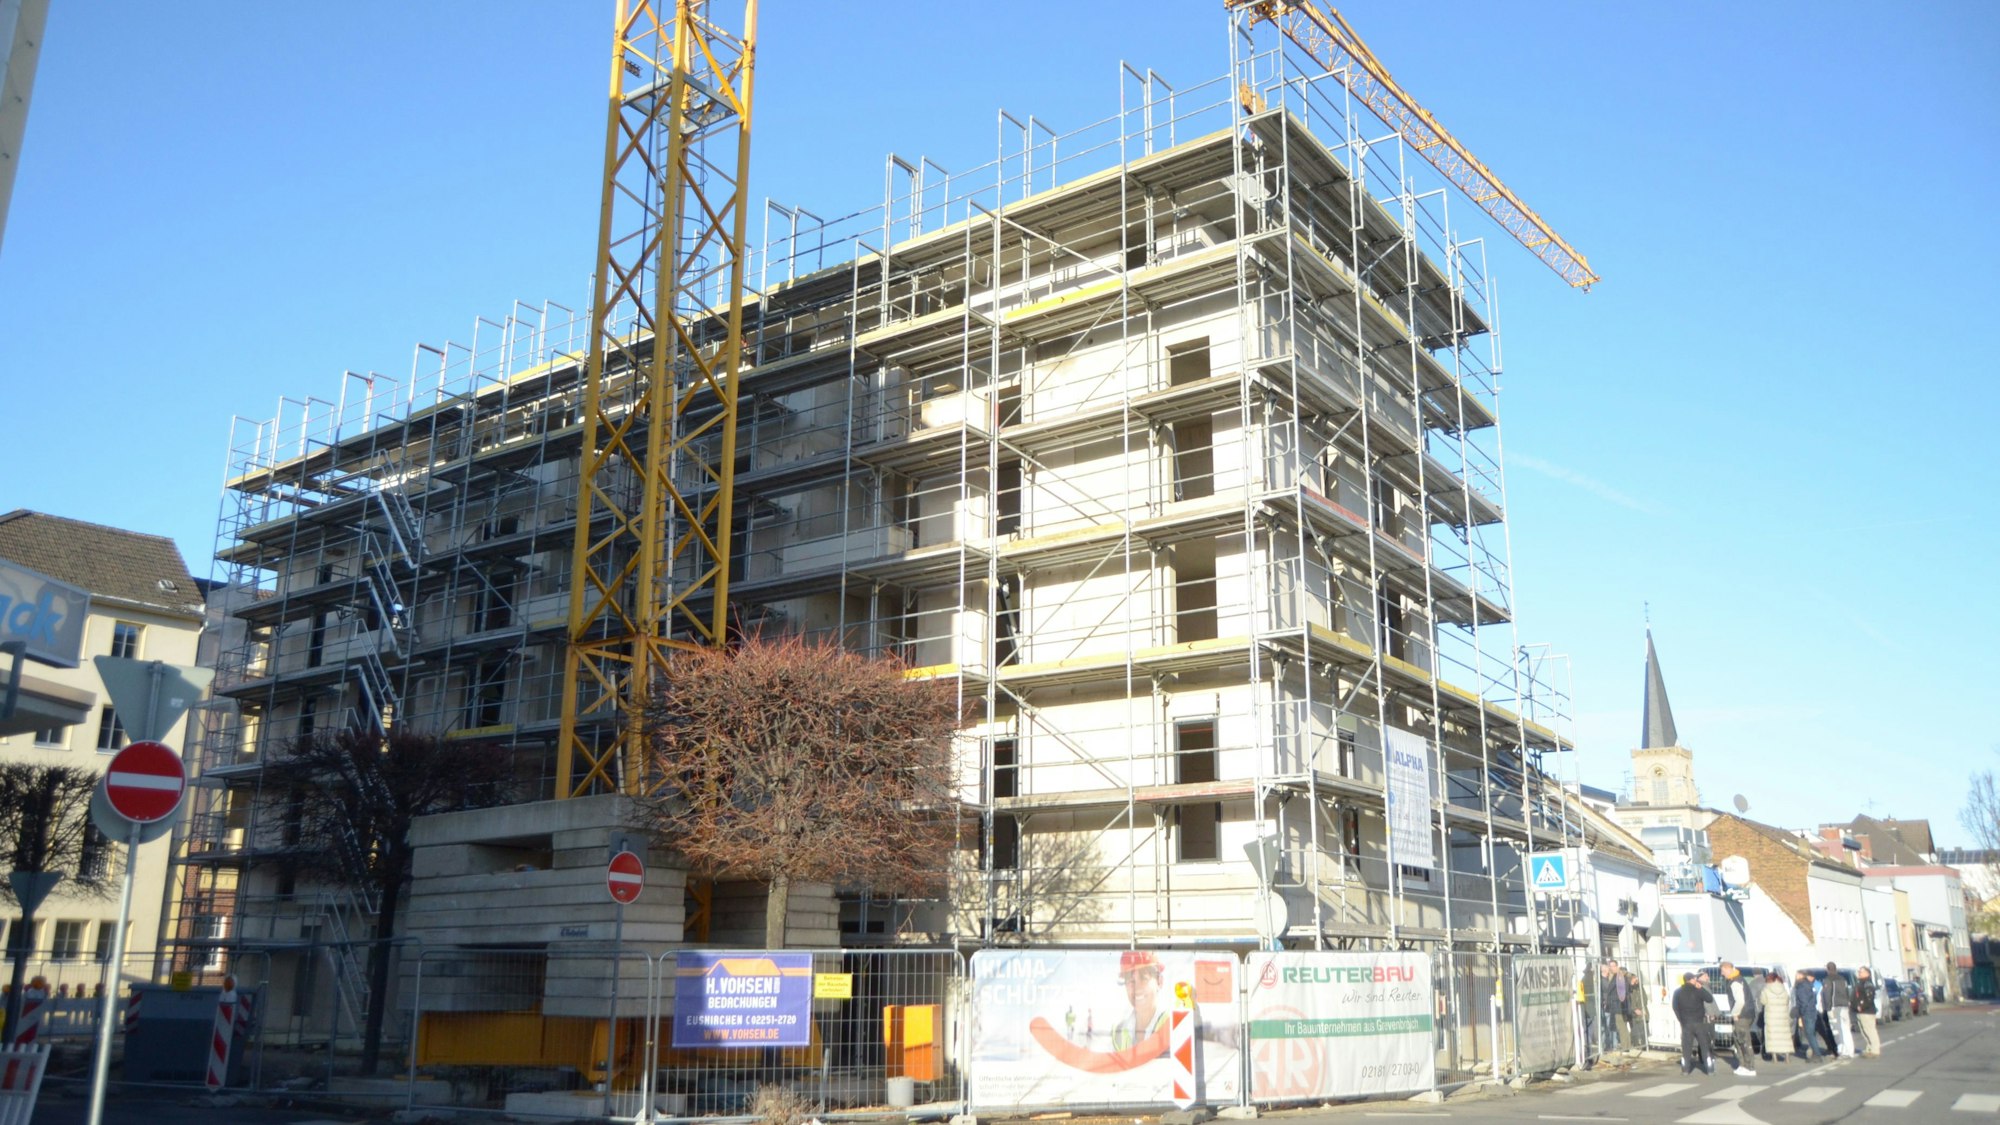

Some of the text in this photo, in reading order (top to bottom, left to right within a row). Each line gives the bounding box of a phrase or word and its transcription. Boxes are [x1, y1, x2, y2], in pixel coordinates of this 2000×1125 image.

[1394, 751, 1424, 771] ALPHA
[981, 958, 1055, 979] KLIMA-
[1282, 965, 1414, 984] REUTERBAU
[706, 977, 773, 994] H.VOHSEN
[708, 996, 777, 1009] BEDACHUNGEN
[1342, 988, 1361, 1004] Wir
[686, 1014, 797, 1026] EUSKIRCHEN 02251-2720
[1284, 1023, 1296, 1035] Ihr
[1297, 1020, 1362, 1034] Bauunternehmen
[1363, 1021, 1376, 1033] aus
[703, 1028, 780, 1040] WWW.VOHSEN.DE
